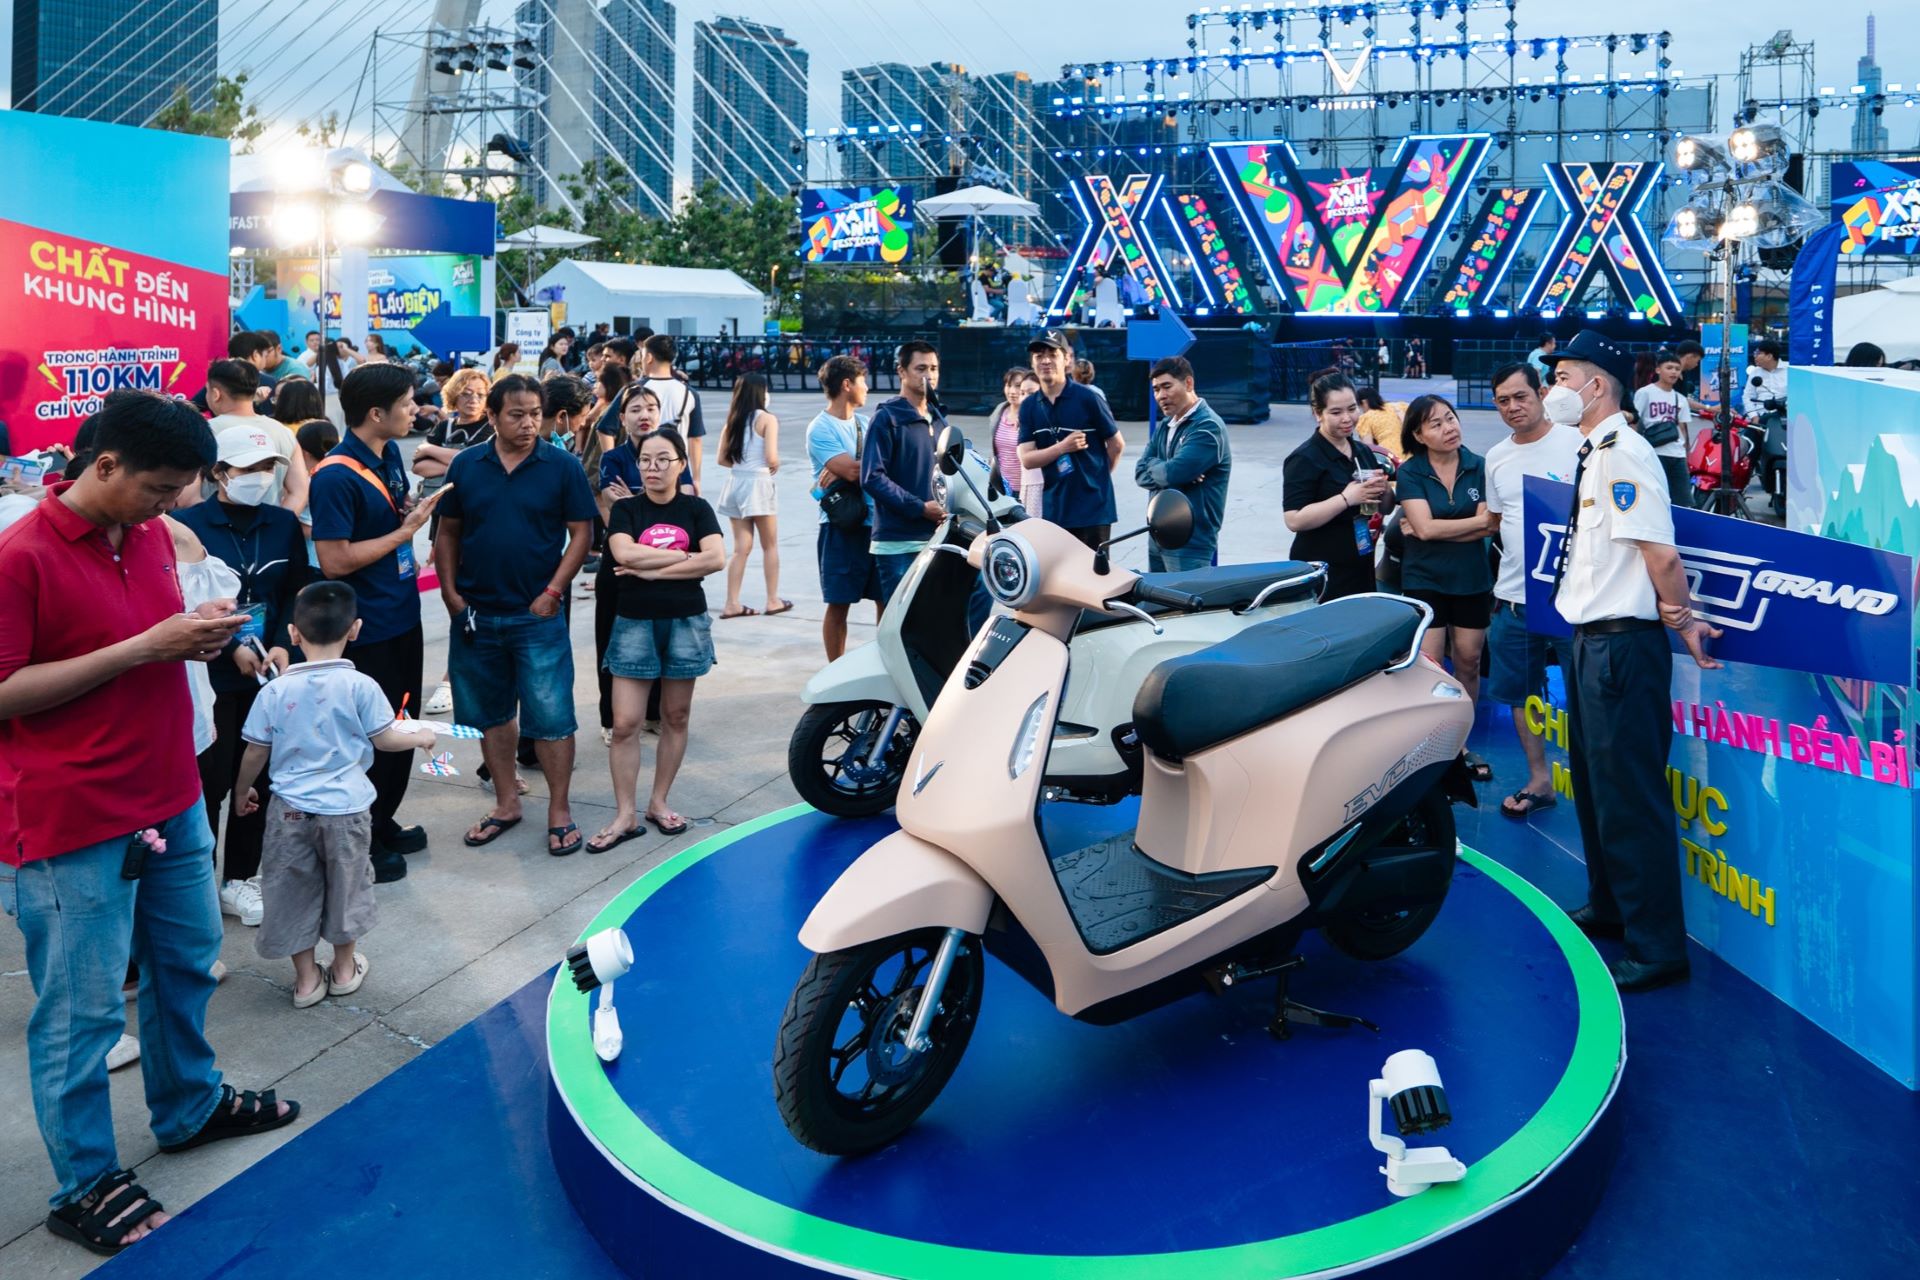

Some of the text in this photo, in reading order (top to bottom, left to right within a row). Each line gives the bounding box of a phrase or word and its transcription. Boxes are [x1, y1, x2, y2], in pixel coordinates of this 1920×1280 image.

[830, 206, 880, 239] XANH
[24, 271, 196, 331] KHUNG HÌNH
[30, 240, 189, 303] CHẤT ĐẾN
[46, 345, 178, 364] TRONG HÀNH TRÌNH
[64, 365, 161, 395] 110KM
[1752, 570, 1898, 616] GRAND
[1690, 700, 1782, 757] HÀNH
[1869, 728, 1910, 789] BỈ
[1343, 753, 1412, 824] EVO
[1665, 764, 1729, 837] ỤC
[1681, 836, 1776, 927] TRÌNH
